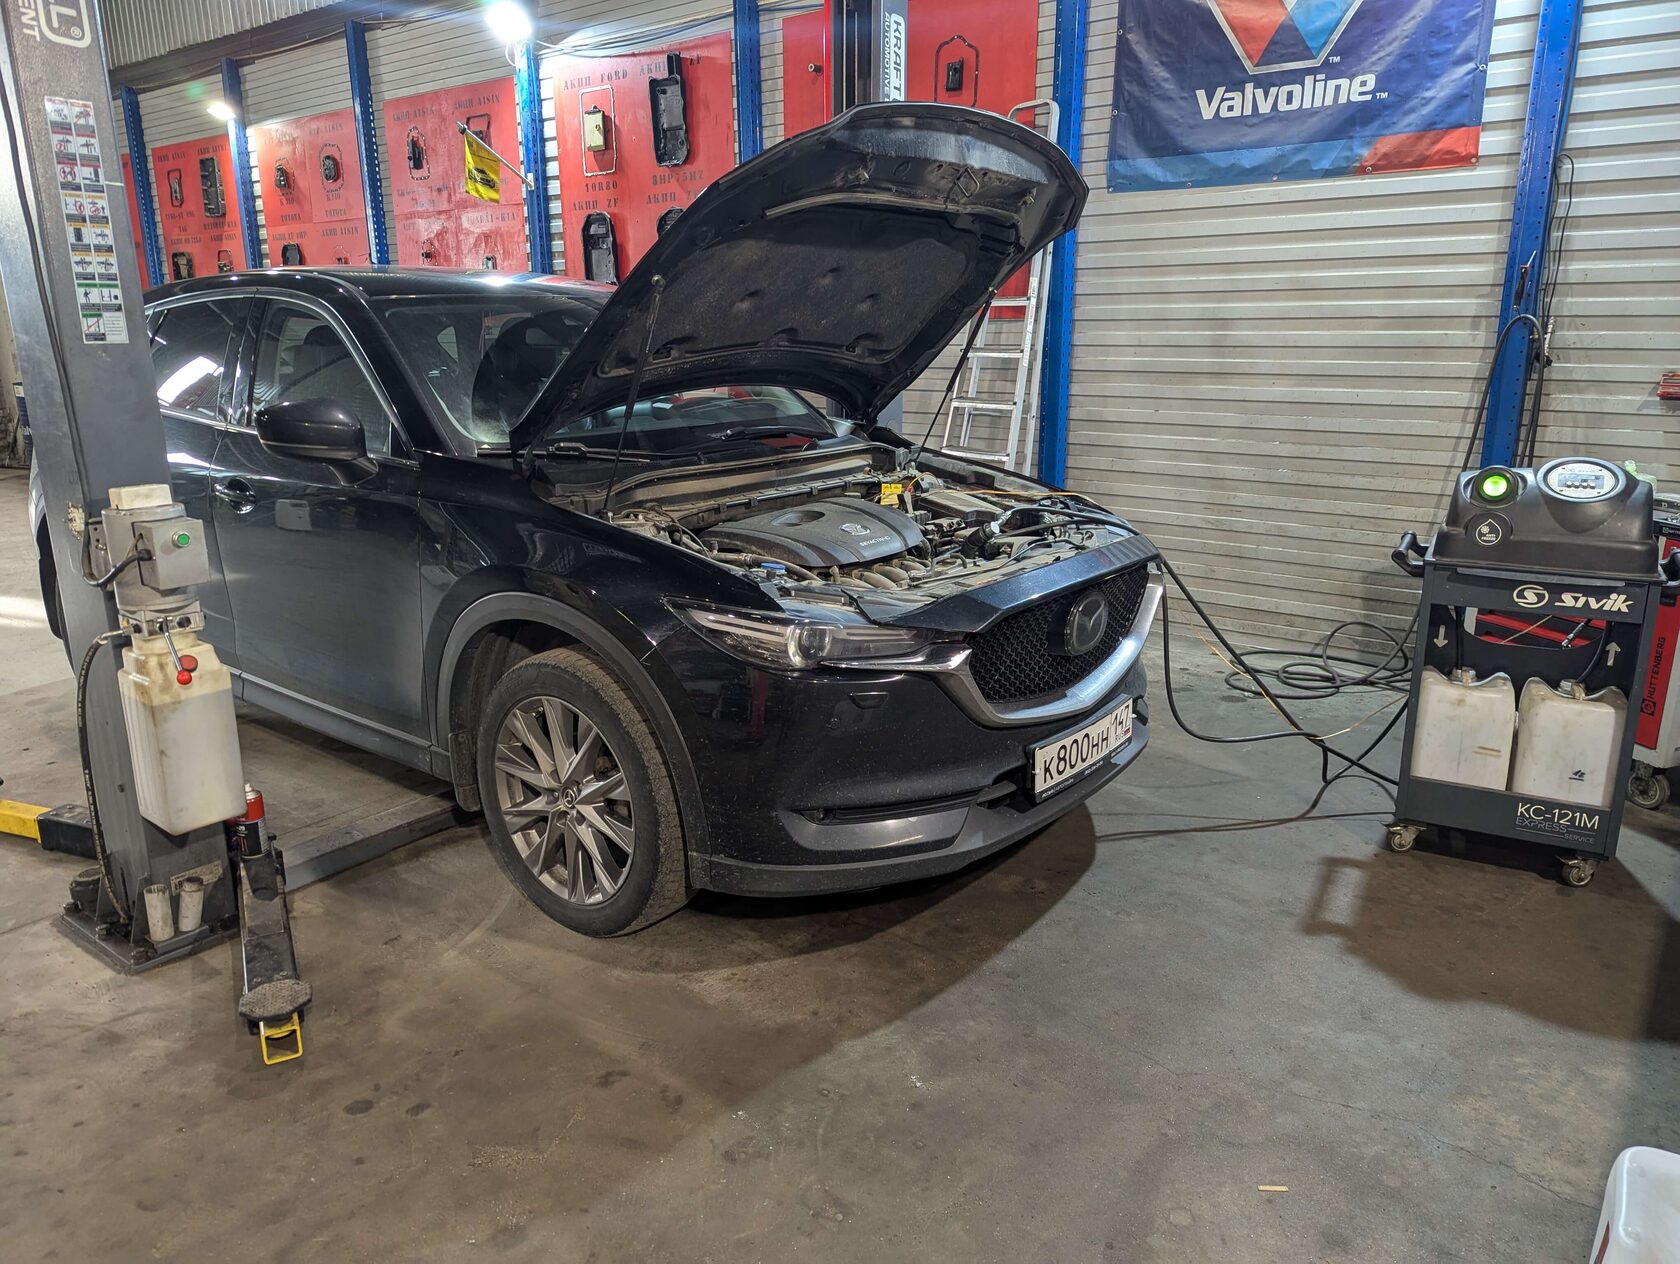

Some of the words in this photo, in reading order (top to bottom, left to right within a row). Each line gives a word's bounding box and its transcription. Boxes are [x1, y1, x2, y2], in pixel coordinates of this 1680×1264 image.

[600, 69, 628, 83] FORD
[1195, 73, 1376, 120] Valvoline
[585, 180, 618, 193] 10R80
[1515, 816, 1568, 833] EXPRESS
[1517, 802, 1600, 830] KC-121M
